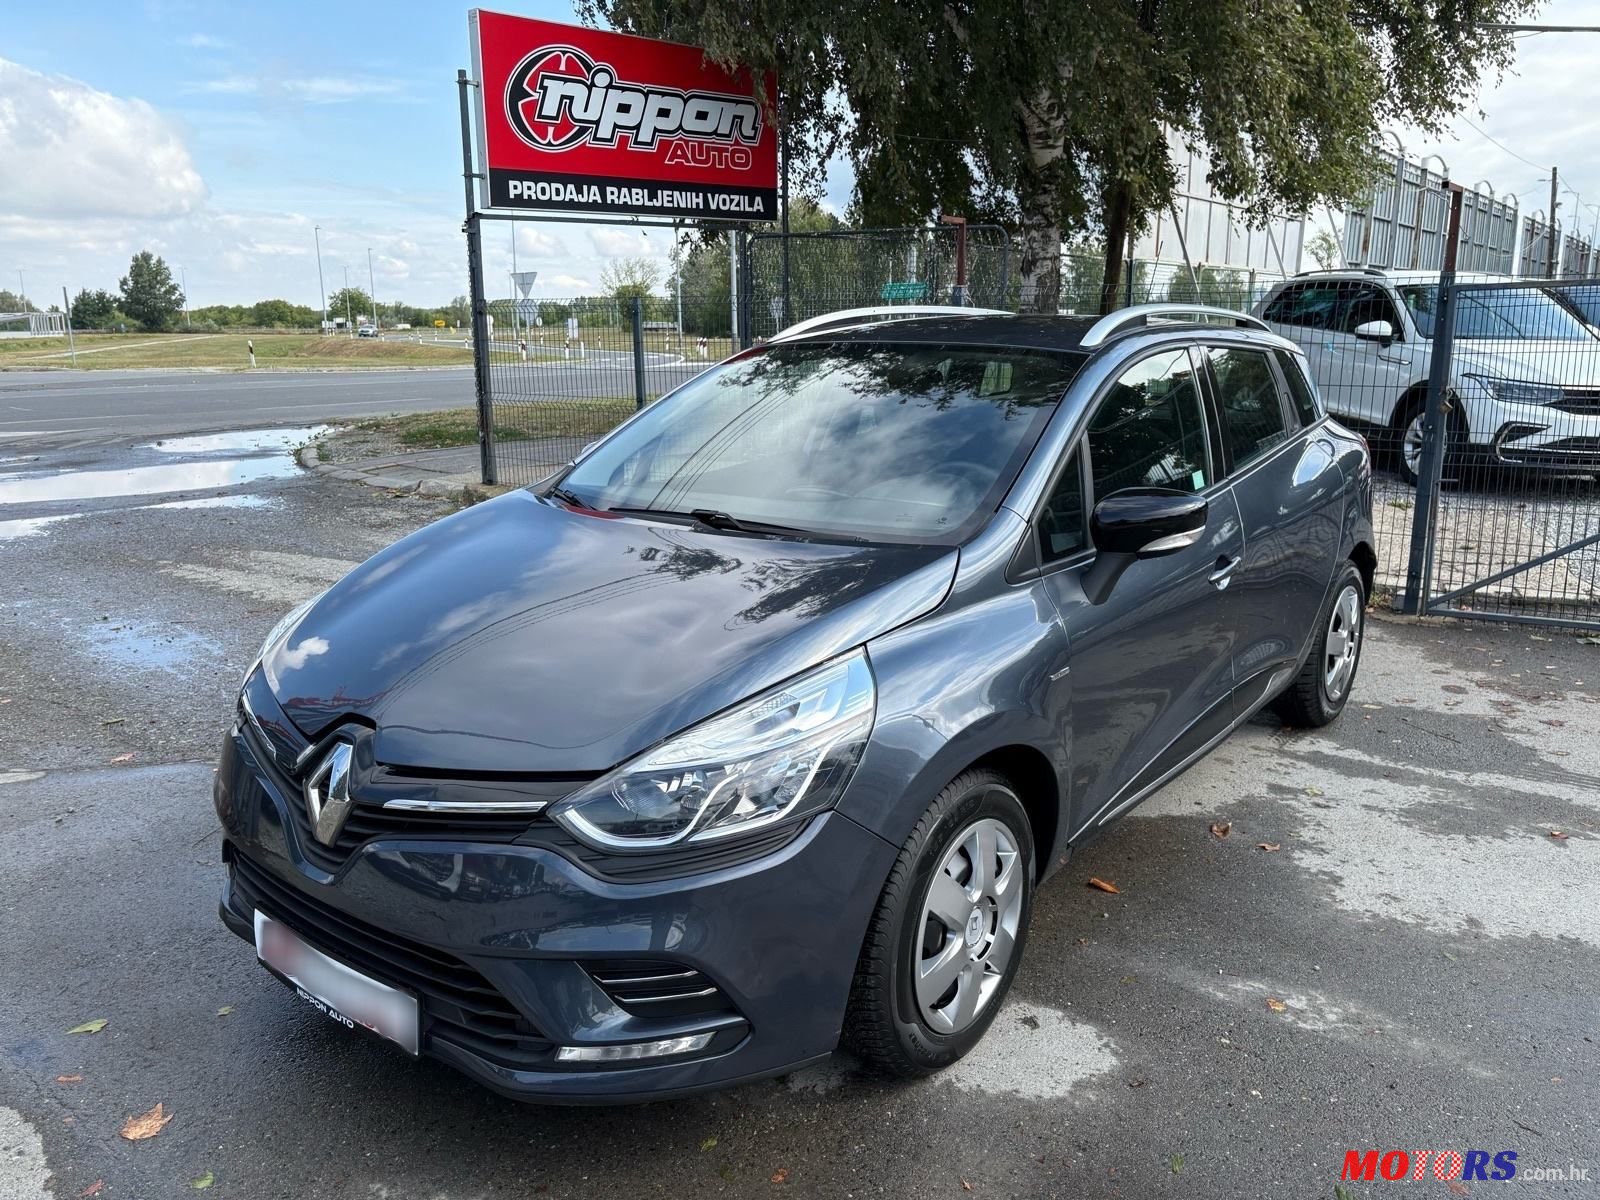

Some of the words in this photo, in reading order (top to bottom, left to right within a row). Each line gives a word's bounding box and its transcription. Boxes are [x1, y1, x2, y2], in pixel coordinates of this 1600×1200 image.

[537, 67, 761, 147] nippon
[664, 141, 752, 170] AUTO
[508, 180, 602, 204] PRODAJA
[606, 187, 703, 210] RABLJENIH
[708, 193, 764, 213] VOZILA
[296, 987, 327, 1013] NIPPON
[329, 1009, 354, 1029] AUTO
